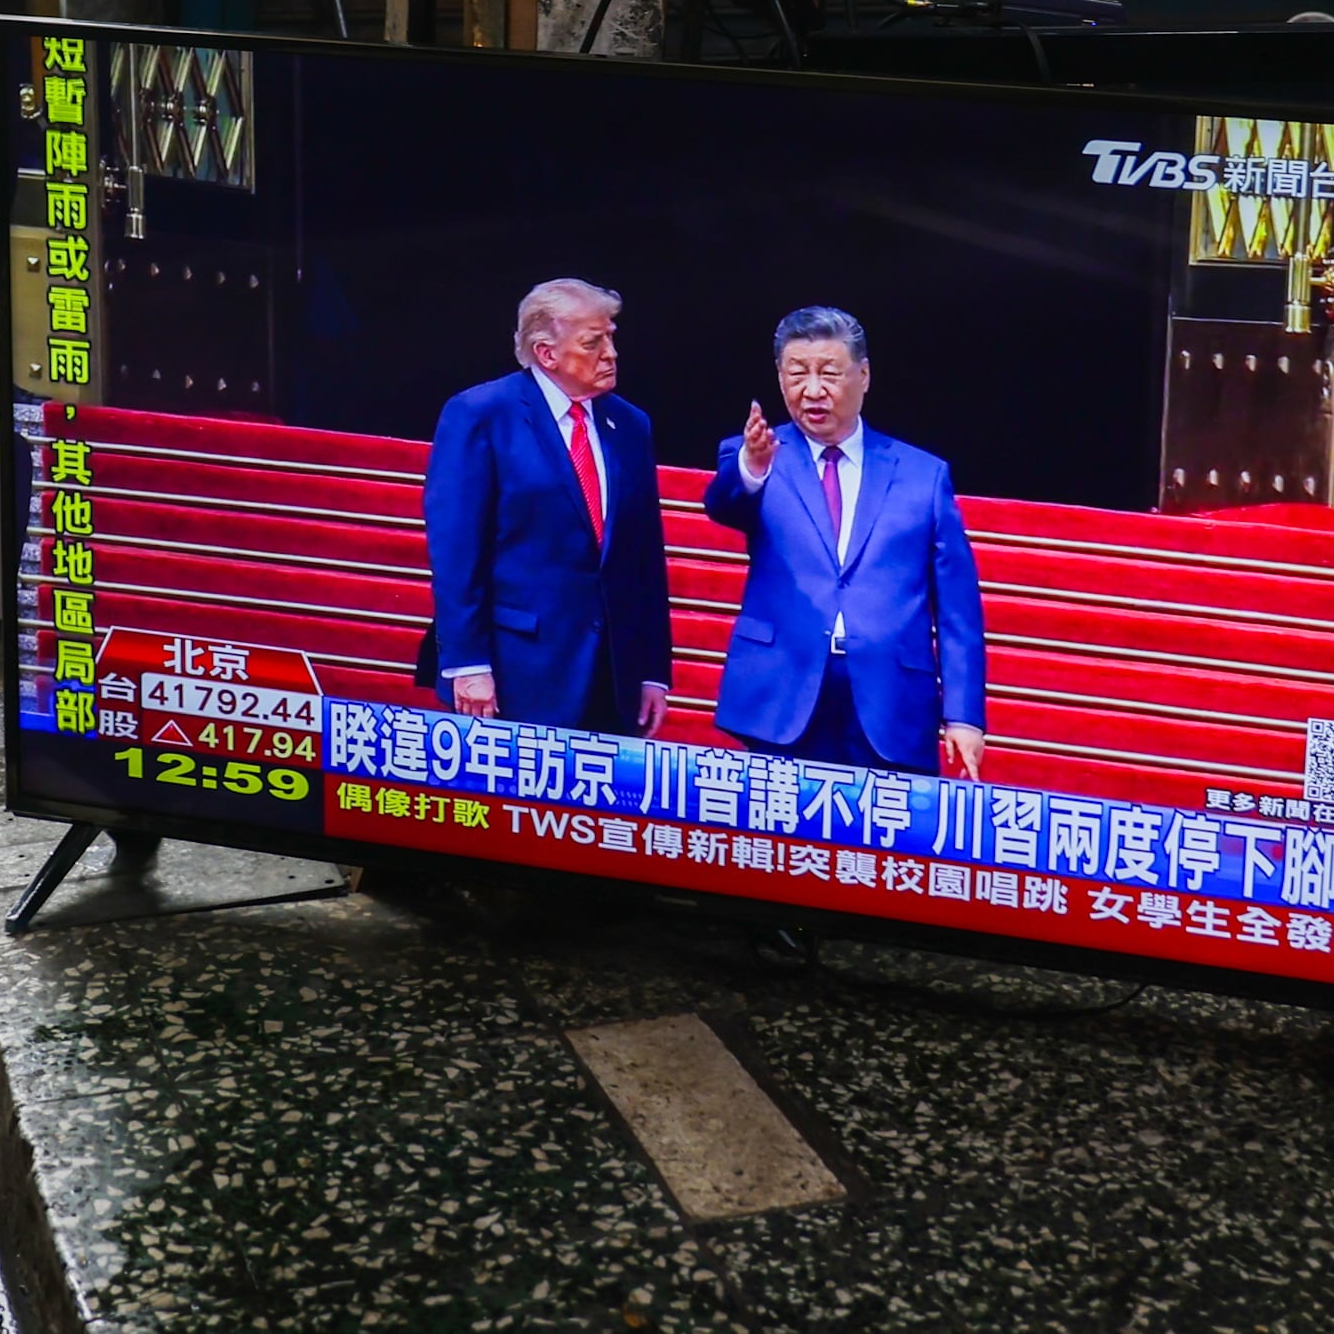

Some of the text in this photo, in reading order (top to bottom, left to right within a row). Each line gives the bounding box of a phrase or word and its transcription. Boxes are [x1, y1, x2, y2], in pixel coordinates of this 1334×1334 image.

[163, 637, 250, 681] 北京
[148, 680, 315, 726] 41792.44
[198, 722, 316, 762] 417.94
[114, 747, 310, 801] 12:59
[330, 703, 619, 812] 睽違9年訪京
[640, 743, 912, 850] 川普講不停
[336, 781, 490, 830] 偶像打歌
